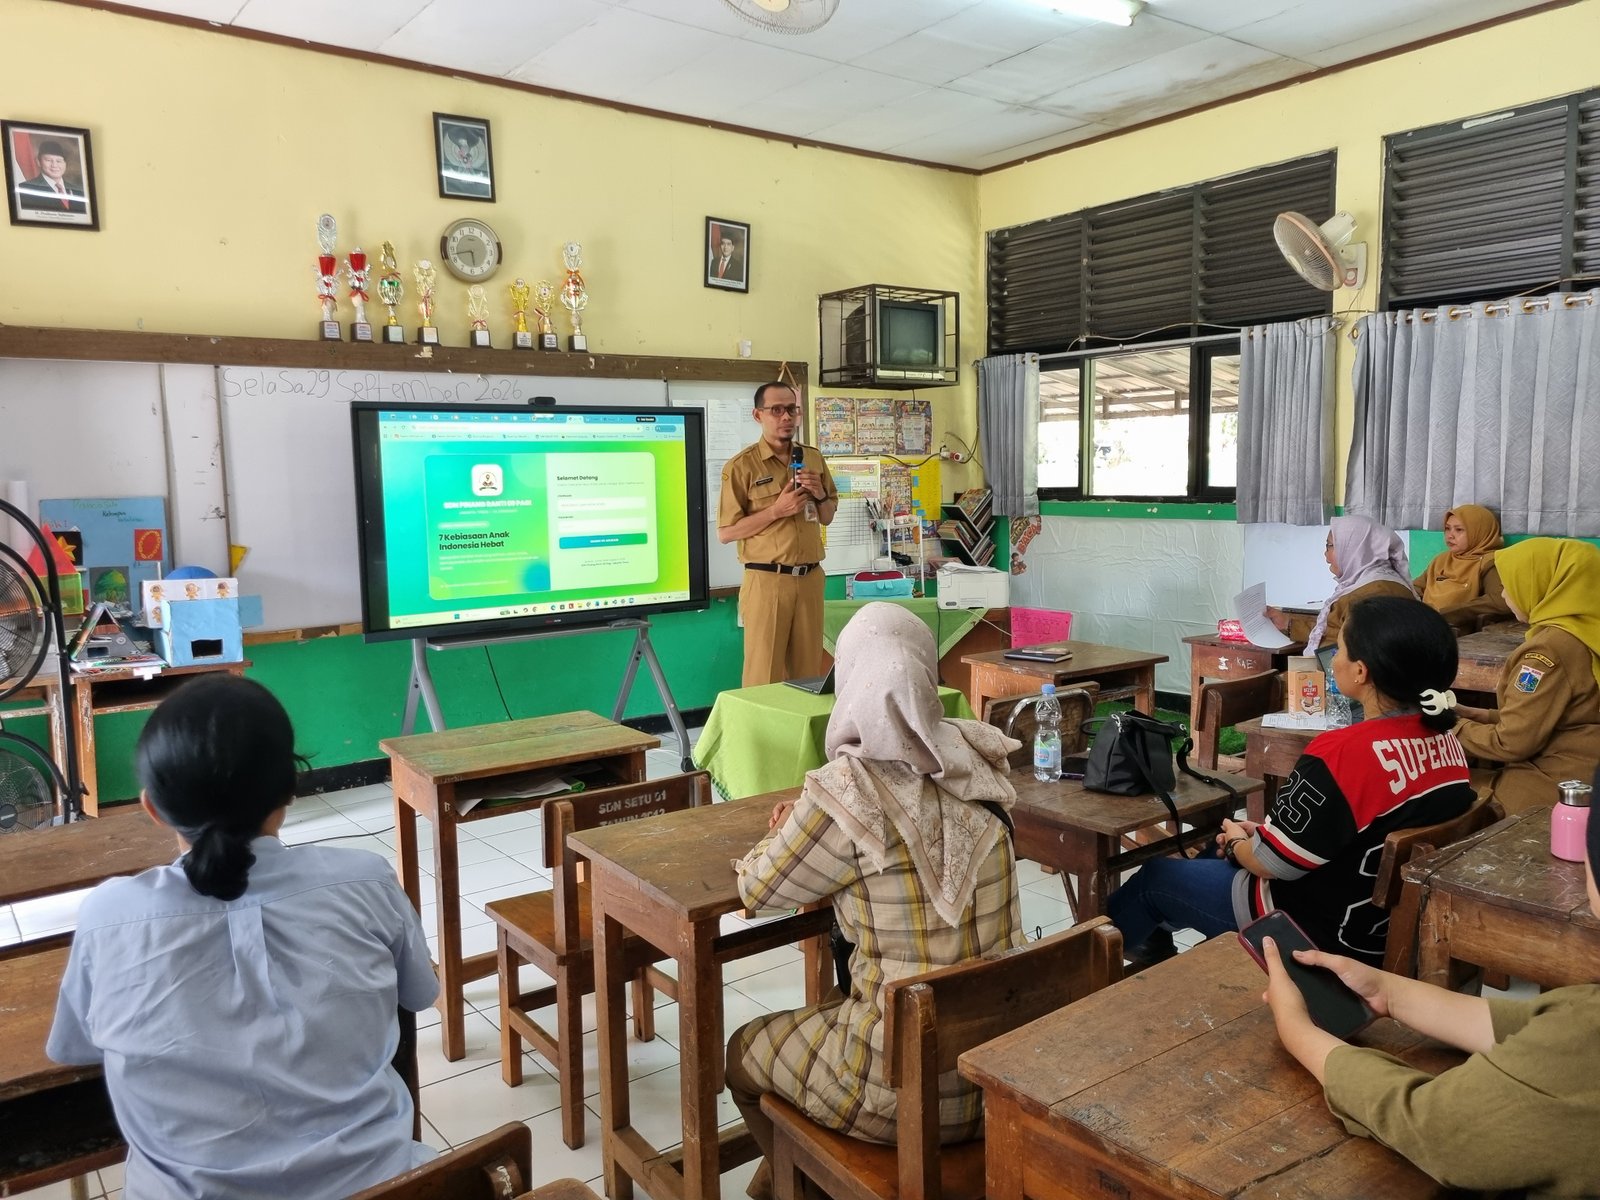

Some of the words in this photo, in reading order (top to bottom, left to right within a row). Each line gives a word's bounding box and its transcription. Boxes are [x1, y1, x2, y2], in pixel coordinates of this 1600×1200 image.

[474, 376, 522, 402] 2026
[438, 533, 443, 541] 7
[444, 531, 488, 541] Kebiasaan
[489, 530, 510, 539] Anak
[439, 541, 480, 551] Indonesia
[480, 540, 505, 549] Hebat
[1372, 730, 1469, 795] SUPERIO
[599, 800, 622, 814] SDN
[624, 793, 651, 808] SETU
